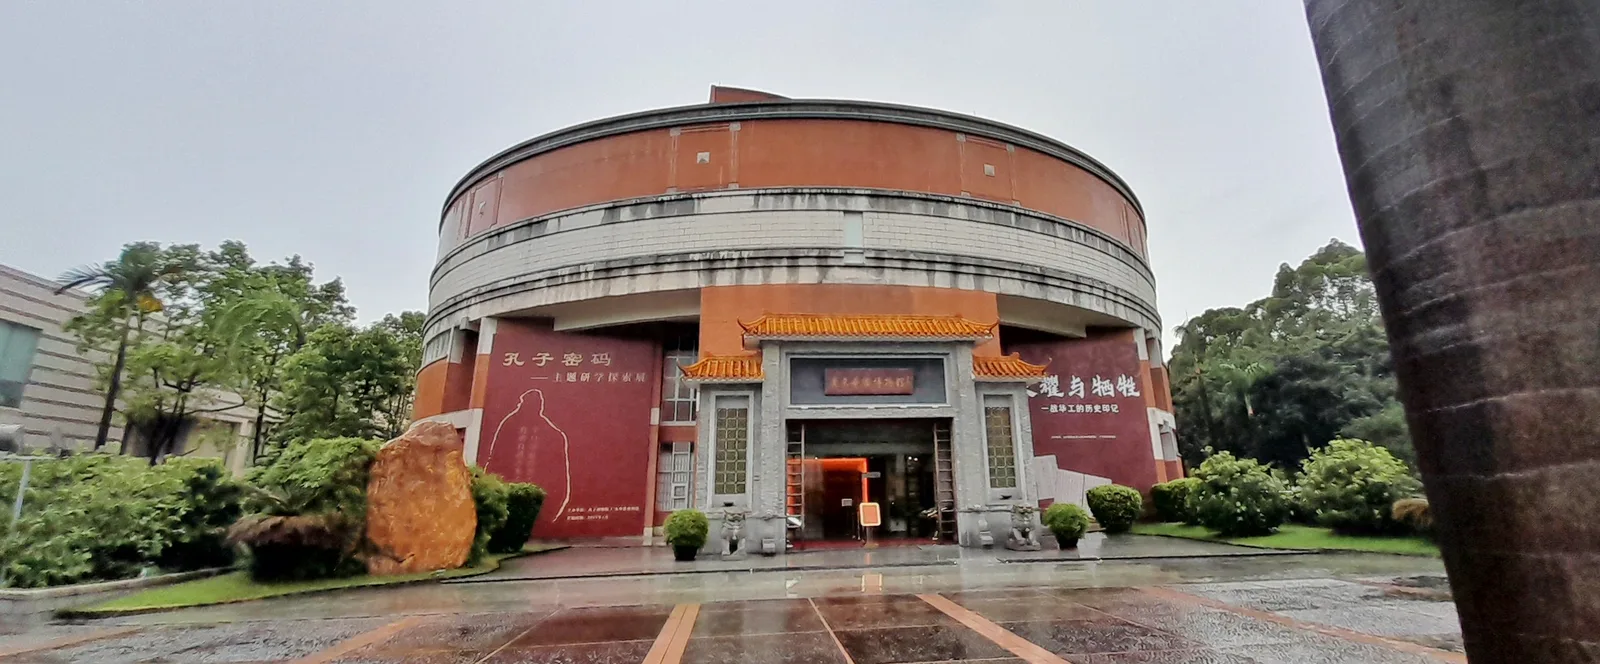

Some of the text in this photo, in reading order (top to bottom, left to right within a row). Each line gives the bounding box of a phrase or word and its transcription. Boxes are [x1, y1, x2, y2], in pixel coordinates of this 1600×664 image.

[503, 352, 612, 367] 孔子密码
[1026, 373, 1141, 399] 耀与牺牲
[1041, 404, 1119, 413] 一战华工的历史印记
